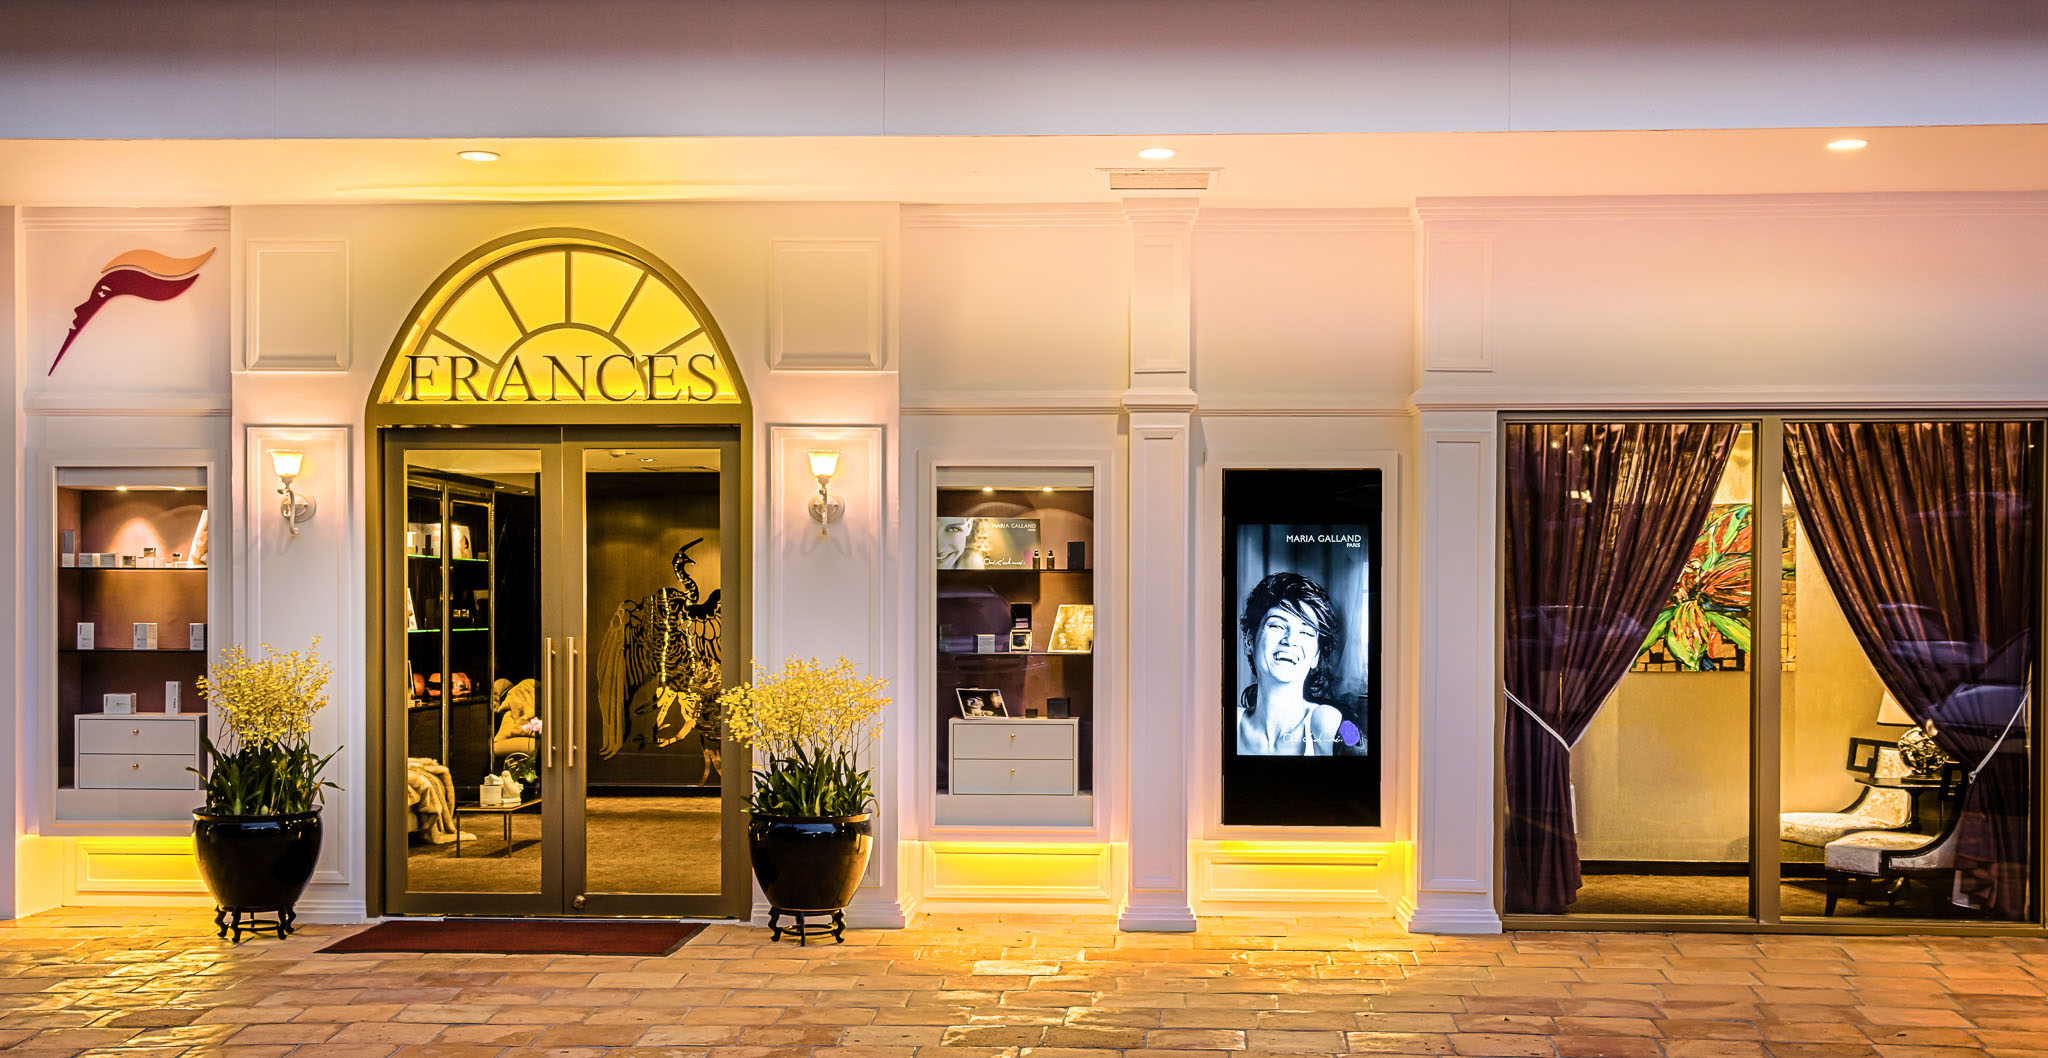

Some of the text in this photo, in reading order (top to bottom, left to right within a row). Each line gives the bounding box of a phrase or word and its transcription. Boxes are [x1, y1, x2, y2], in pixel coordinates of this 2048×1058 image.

[405, 354, 719, 402] FRANCES
[1286, 534, 1362, 543] MARIA GALLAND
